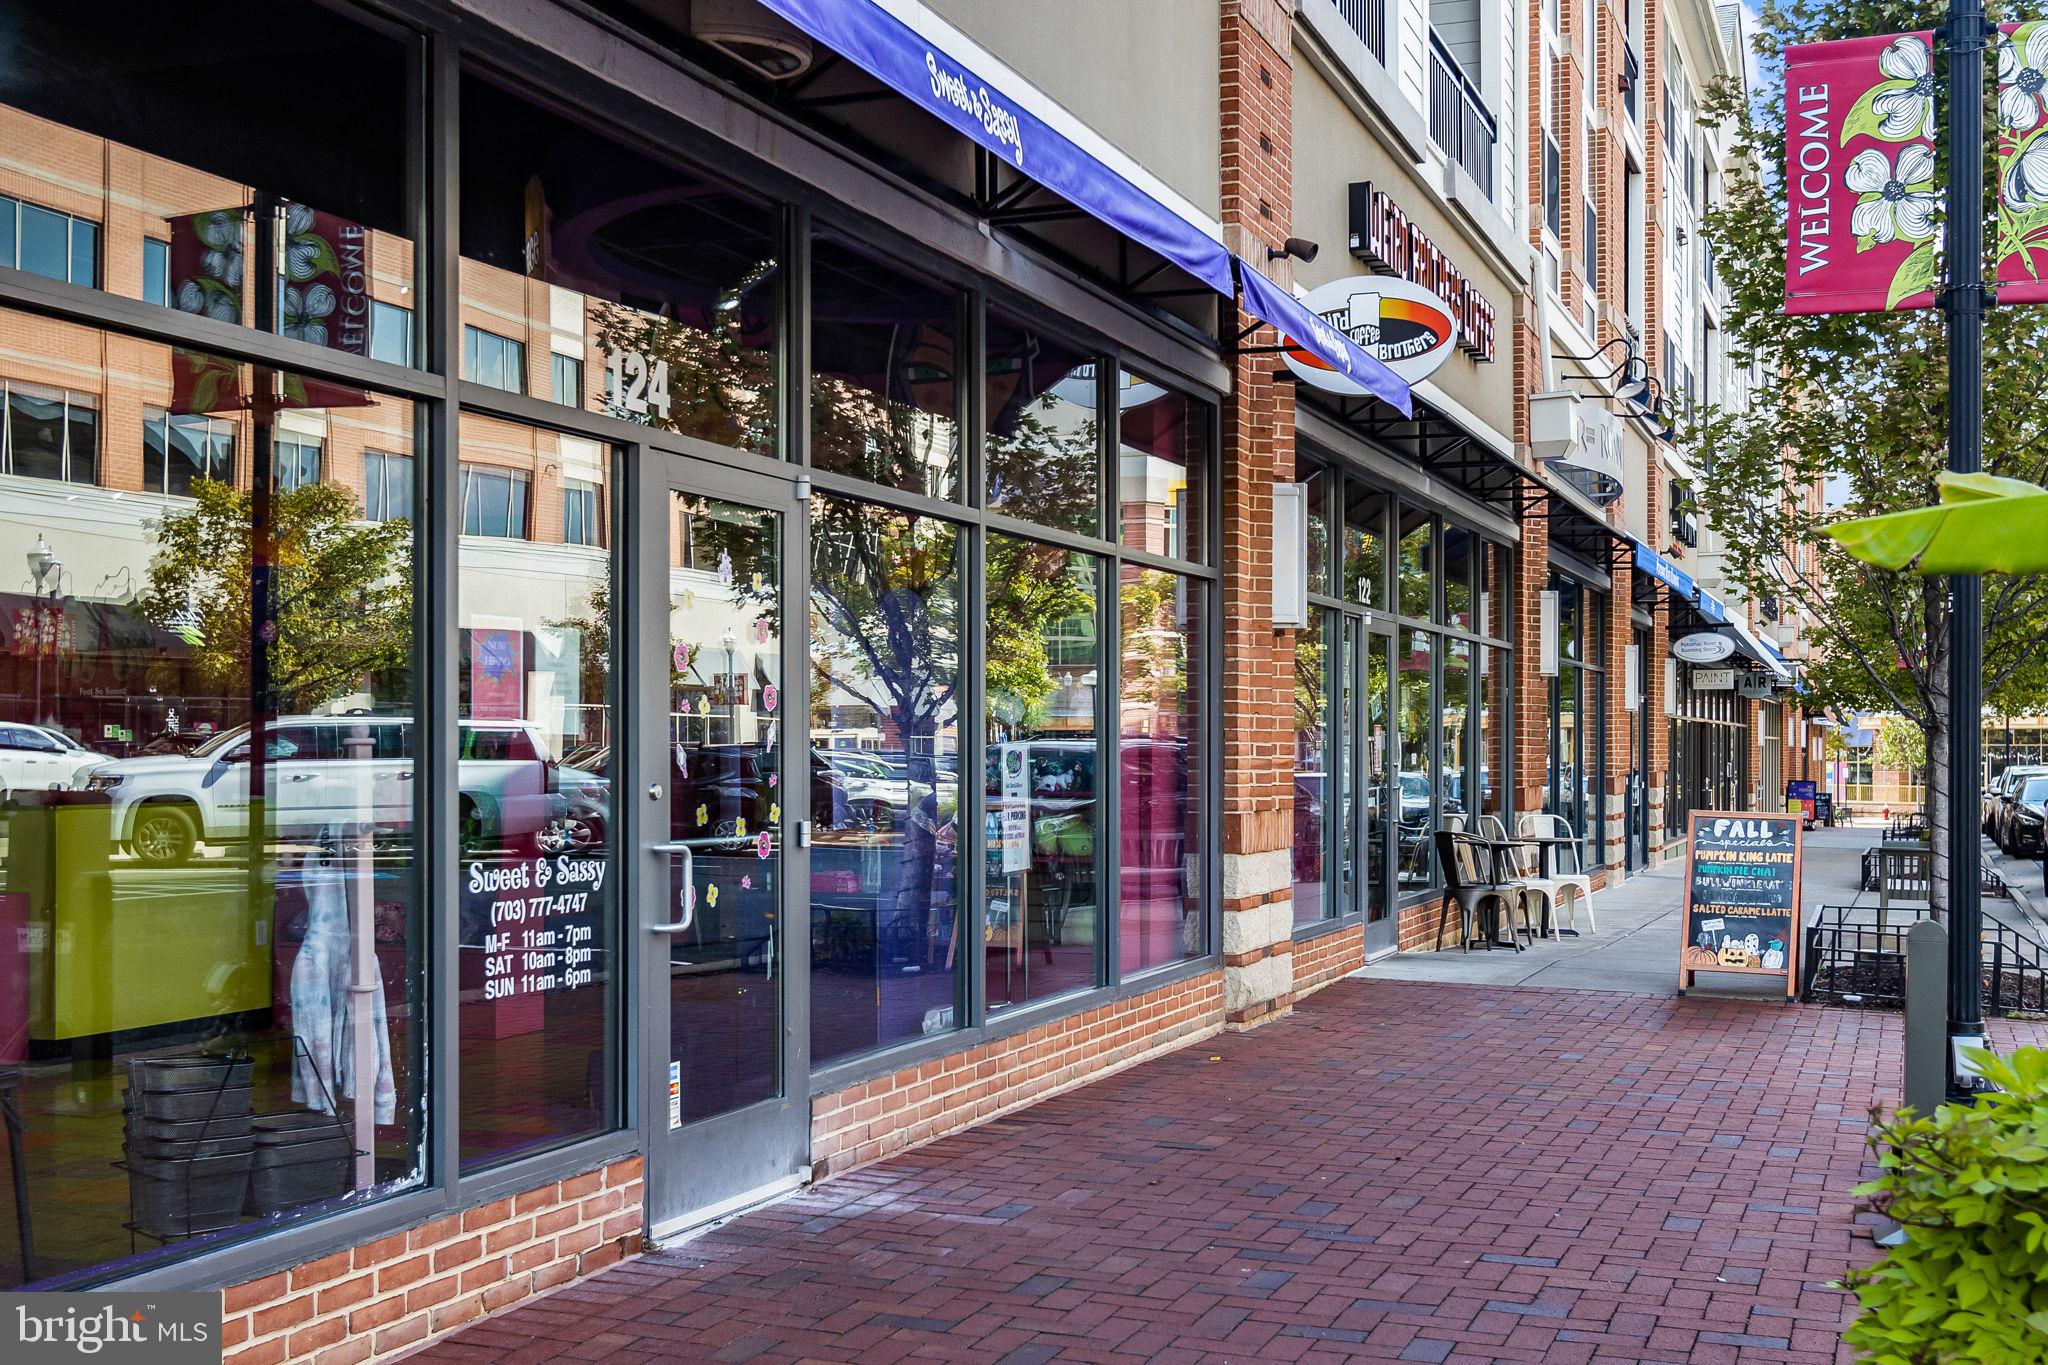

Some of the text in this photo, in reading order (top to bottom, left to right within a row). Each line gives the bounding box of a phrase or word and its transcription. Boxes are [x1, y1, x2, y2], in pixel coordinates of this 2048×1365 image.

[926, 51, 1023, 166] Sweet & Sassy
[1799, 83, 1830, 277] WELCOME
[1463, 280, 1495, 363] COFFEE
[607, 349, 671, 418] 124
[1358, 577, 1371, 604] 122
[1695, 672, 1730, 683] PAINT
[1713, 819, 1774, 839] FALL
[1719, 839, 1776, 849] specials
[1695, 849, 1737, 862] PUMPKIN
[1738, 851, 1764, 862] KING
[1766, 852, 1794, 864] LATTE
[1697, 864, 1777, 877] PUMPKIN PIE CHAI
[469, 855, 606, 894] Sweet & Sassy
[490, 892, 588, 927] (703) 777-4747
[1692, 903, 1726, 915] SALTED
[1727, 904, 1766, 916] CARAMEL
[485, 932, 511, 954] M-F
[521, 930, 555, 948] 11am
[565, 925, 591, 946] 7pm
[485, 954, 514, 977] SAT
[521, 951, 555, 970] 10am
[565, 946, 591, 968] 8pm
[485, 977, 515, 1000] SUN
[521, 973, 555, 993] 11am
[565, 967, 591, 989] 6pm
